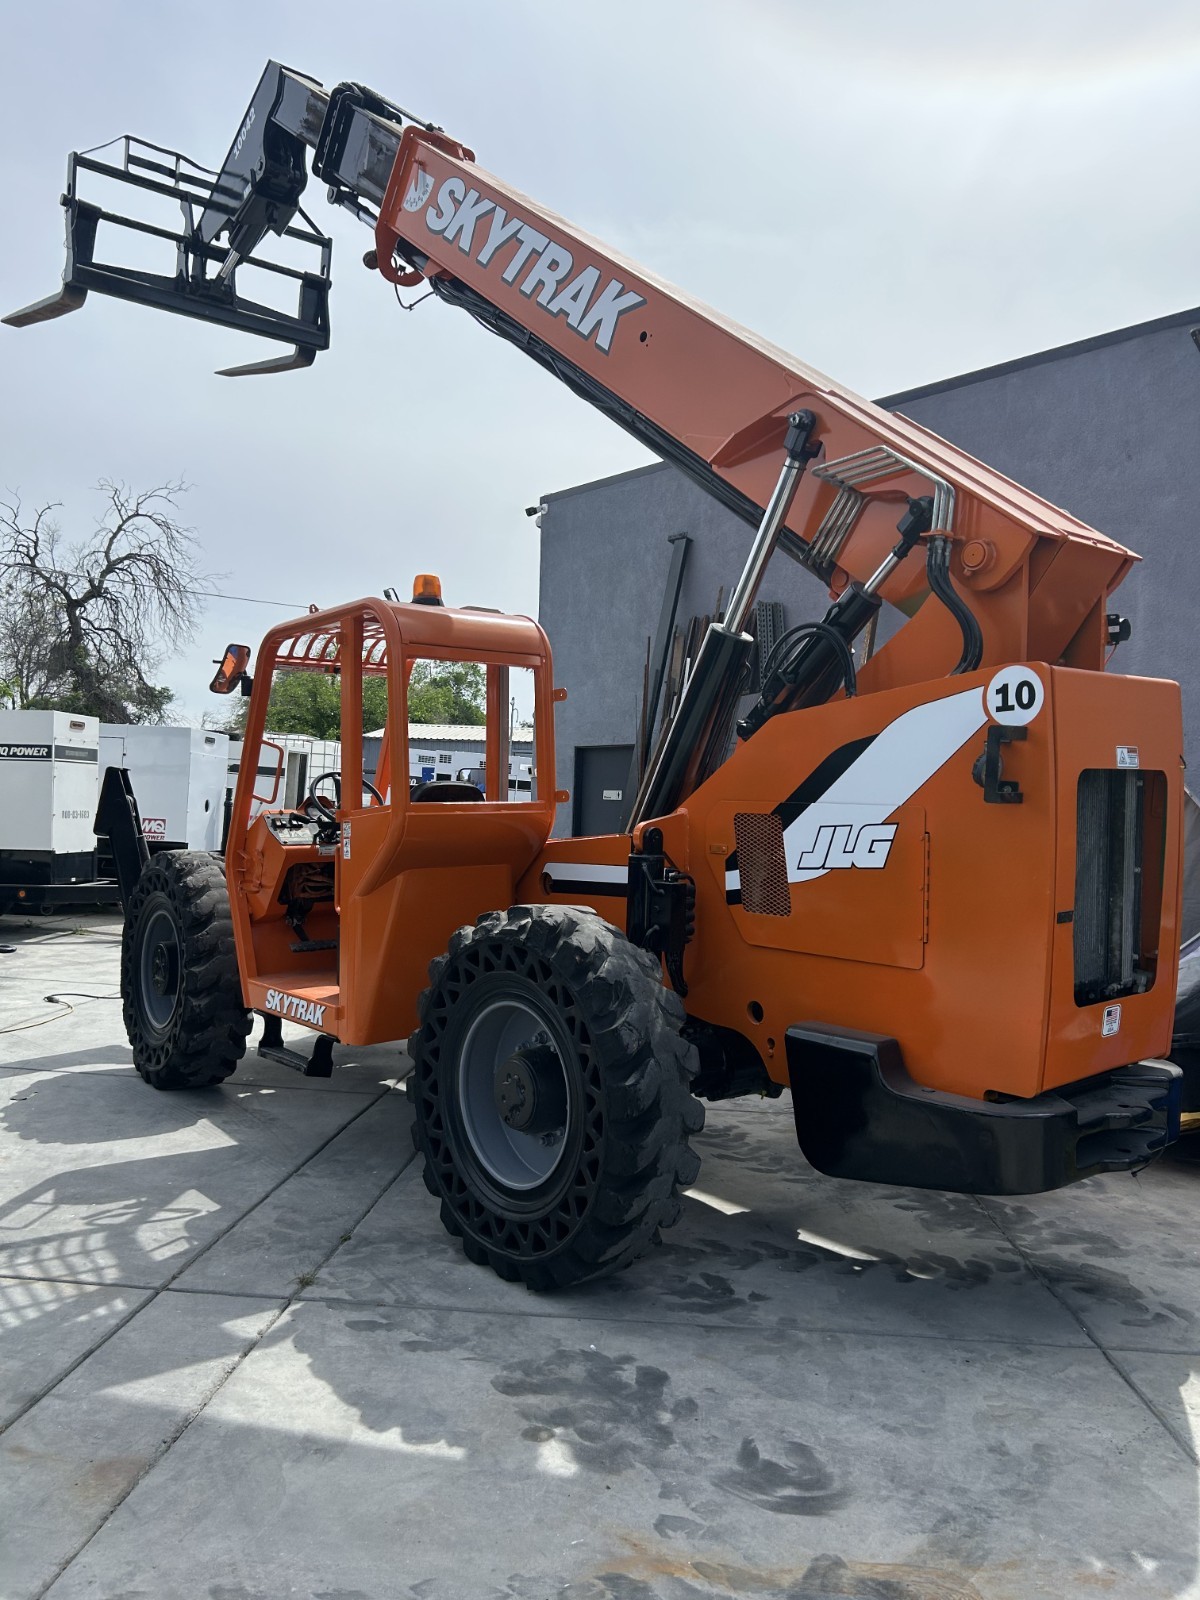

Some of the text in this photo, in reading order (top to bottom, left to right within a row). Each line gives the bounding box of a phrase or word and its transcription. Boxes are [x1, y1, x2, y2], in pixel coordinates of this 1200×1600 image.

[425, 176, 647, 356] SKYTRAK
[995, 680, 1036, 713] 10
[0, 746, 48, 757] Q POWER
[142, 819, 166, 833] MQ
[797, 822, 899, 871] JLG
[265, 989, 327, 1027] SKYTRAK
